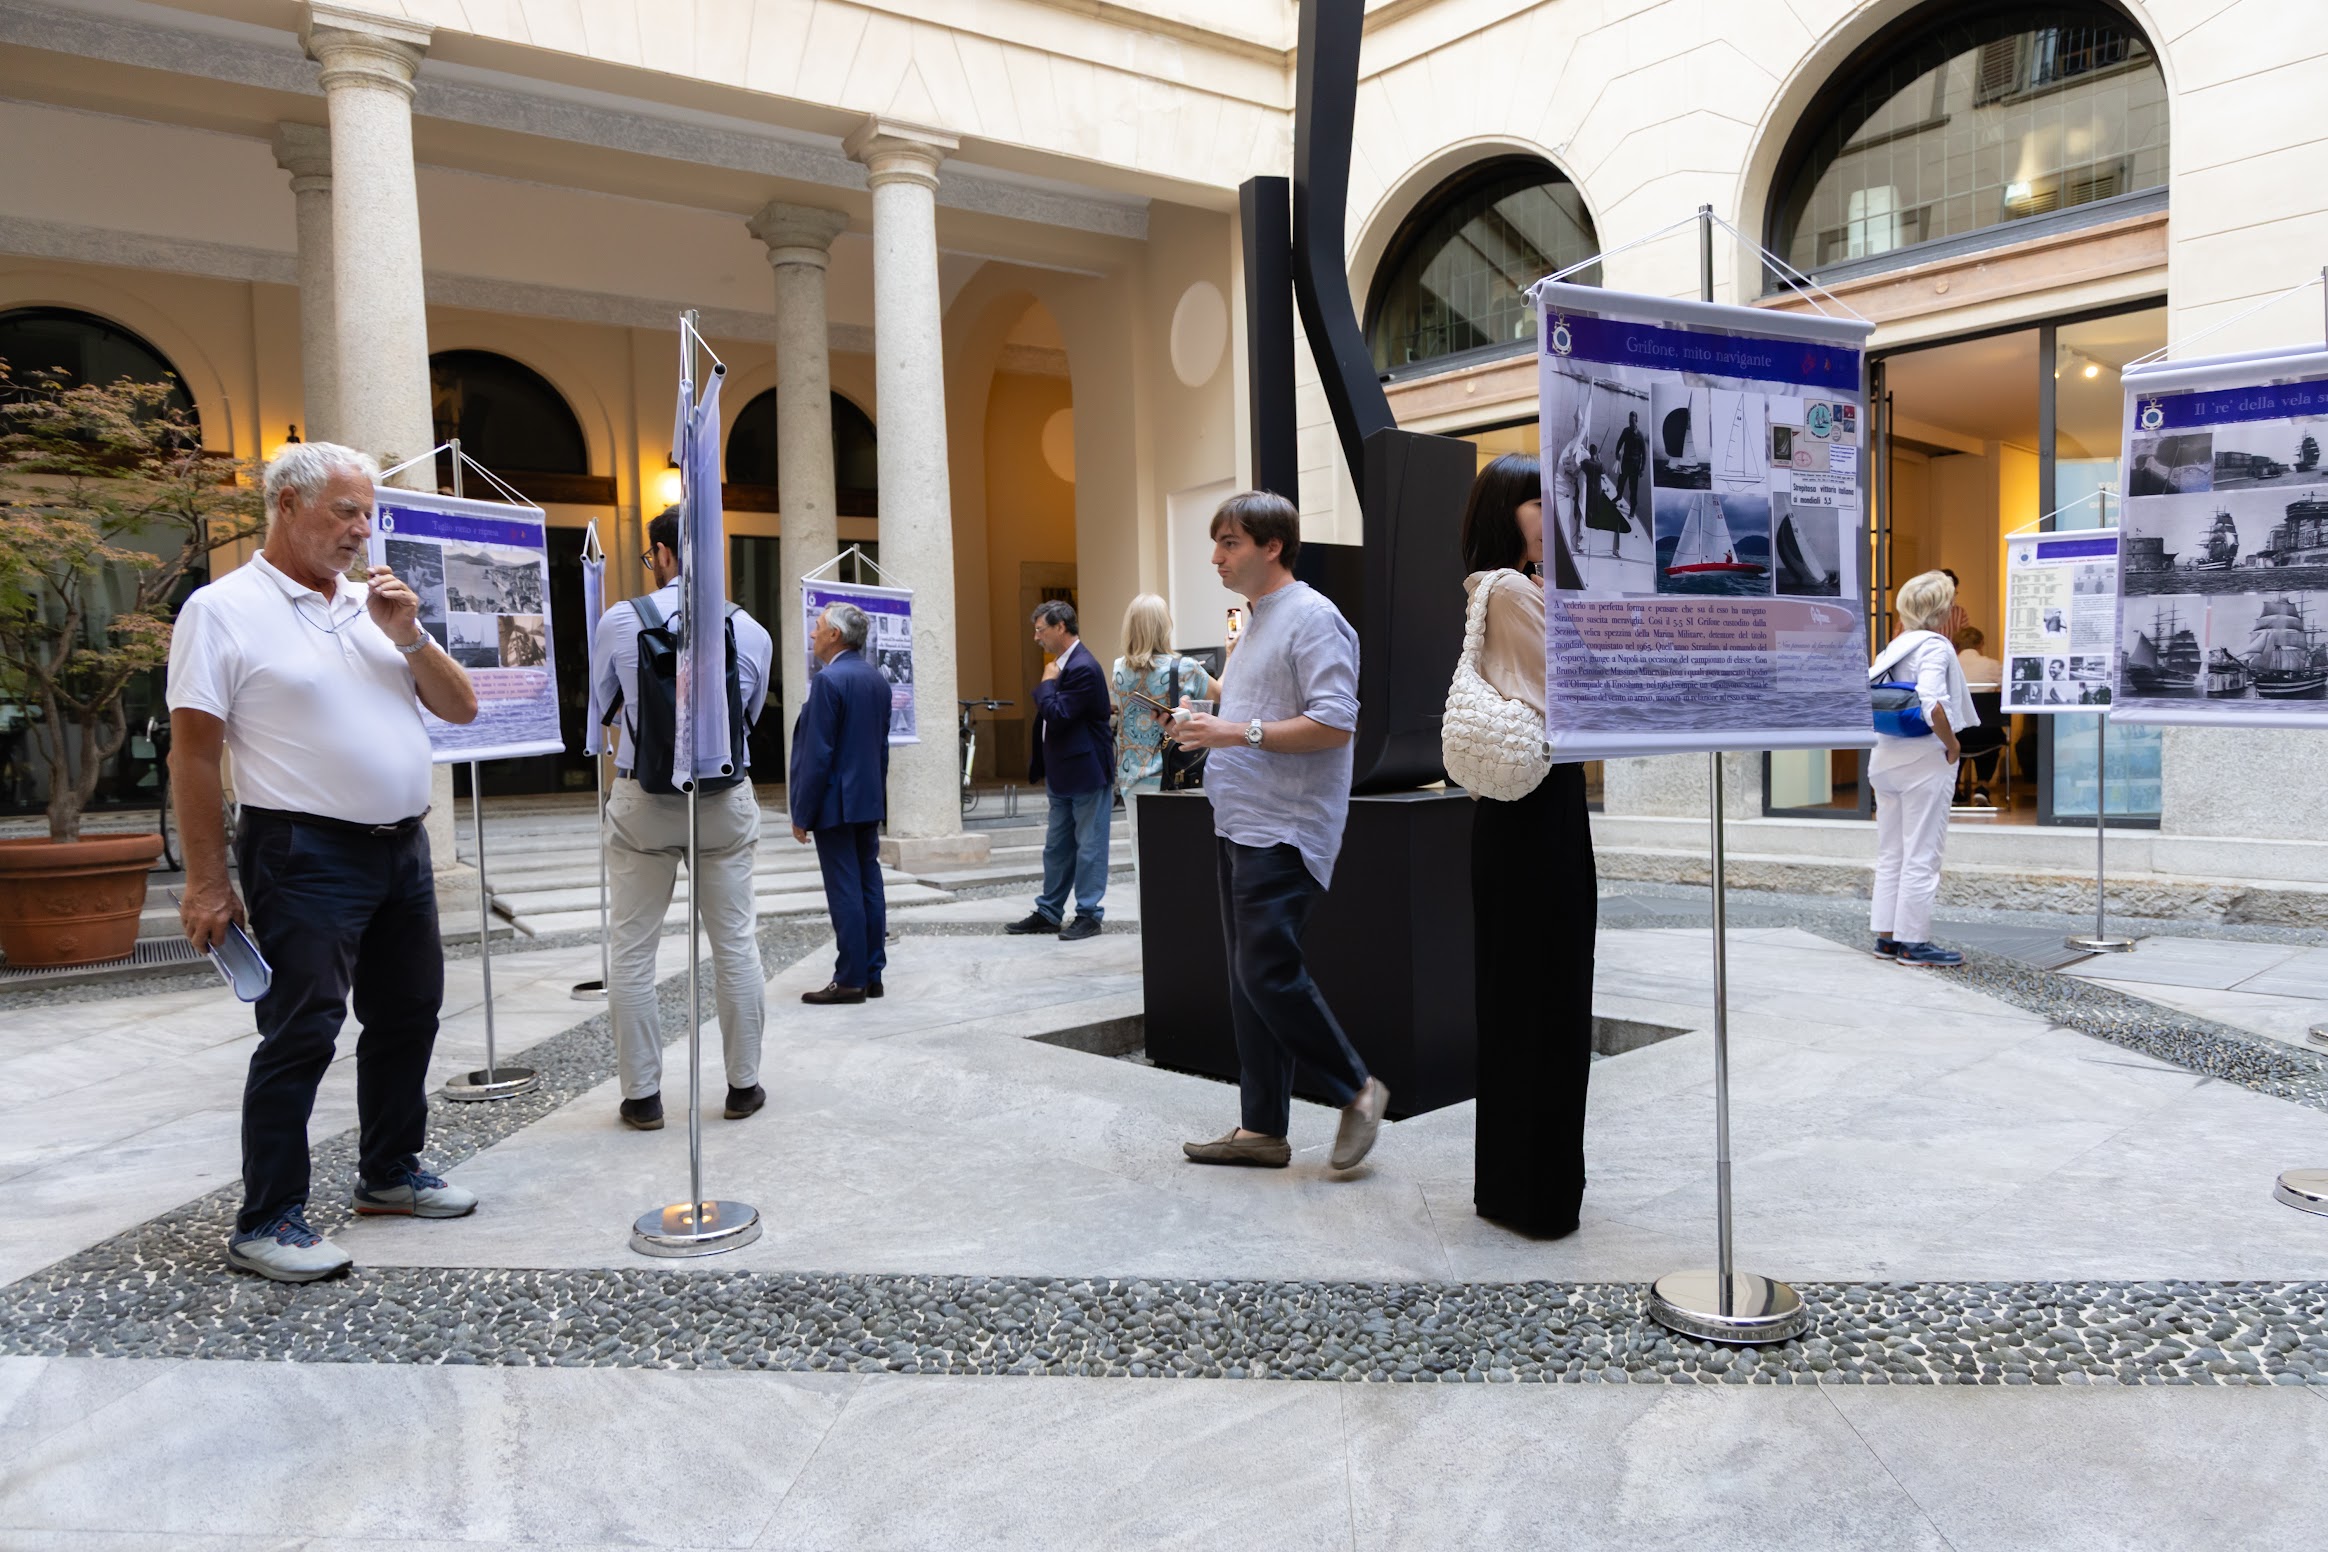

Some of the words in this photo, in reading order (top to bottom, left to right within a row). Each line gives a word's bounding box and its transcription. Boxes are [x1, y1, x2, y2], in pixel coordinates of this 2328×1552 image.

[1626, 336, 1678, 358] Grifone,
[1683, 347, 1711, 360] mito
[1716, 351, 1772, 369] navigante
[2194, 403, 2205, 415] Il
[2239, 396, 2275, 411] della
[2282, 393, 2311, 406] vela
[1793, 483, 1816, 493] Strepitosa
[1820, 485, 1836, 493] vittoria
[1800, 496, 1821, 504] mondiali
[1554, 600, 1560, 609] A
[1563, 601, 1586, 610] vederlo
[1589, 602, 1595, 610] in
[1599, 602, 1623, 612] perfetta
[1627, 602, 1645, 612] forma
[1655, 606, 1678, 614] pensare
[1682, 605, 1693, 613] che
[1709, 605, 1714, 613] di
[1731, 606, 1739, 614] ha
[1742, 606, 1766, 616] navigato
[1611, 616, 1644, 626] meraviglia.
[1666, 617, 1670, 625] il
[1697, 617, 1720, 626] Grifone
[1554, 627, 1580, 635] Sezione
[1584, 628, 1600, 636] velica
[1604, 629, 1632, 639] spezzina
[1635, 629, 1650, 637] della
[1653, 629, 1674, 638] Marina
[1678, 629, 1706, 639] Militare,
[1708, 630, 1735, 639] detentore
[1739, 631, 1748, 639] del
[1752, 631, 1767, 639] titolo
[1555, 640, 1584, 648] mondiale
[1587, 641, 1623, 651] conquistato
[1626, 642, 1635, 650] nel
[1637, 643, 1653, 652] 1965.
[1730, 643, 1756, 651] comando
[1758, 643, 1767, 651] del
[1556, 653, 1587, 664] Vespucci,
[1589, 656, 1610, 664] giunge
[1618, 654, 1638, 664] Napoli
[1648, 655, 1678, 663] occasione
[1680, 655, 1688, 663] del
[1691, 656, 1725, 665] campionato
[1727, 655, 1733, 663] di
[1734, 655, 1753, 663] classe.
[1556, 666, 1577, 675] Bruno
[1610, 667, 1638, 675] Massimo
